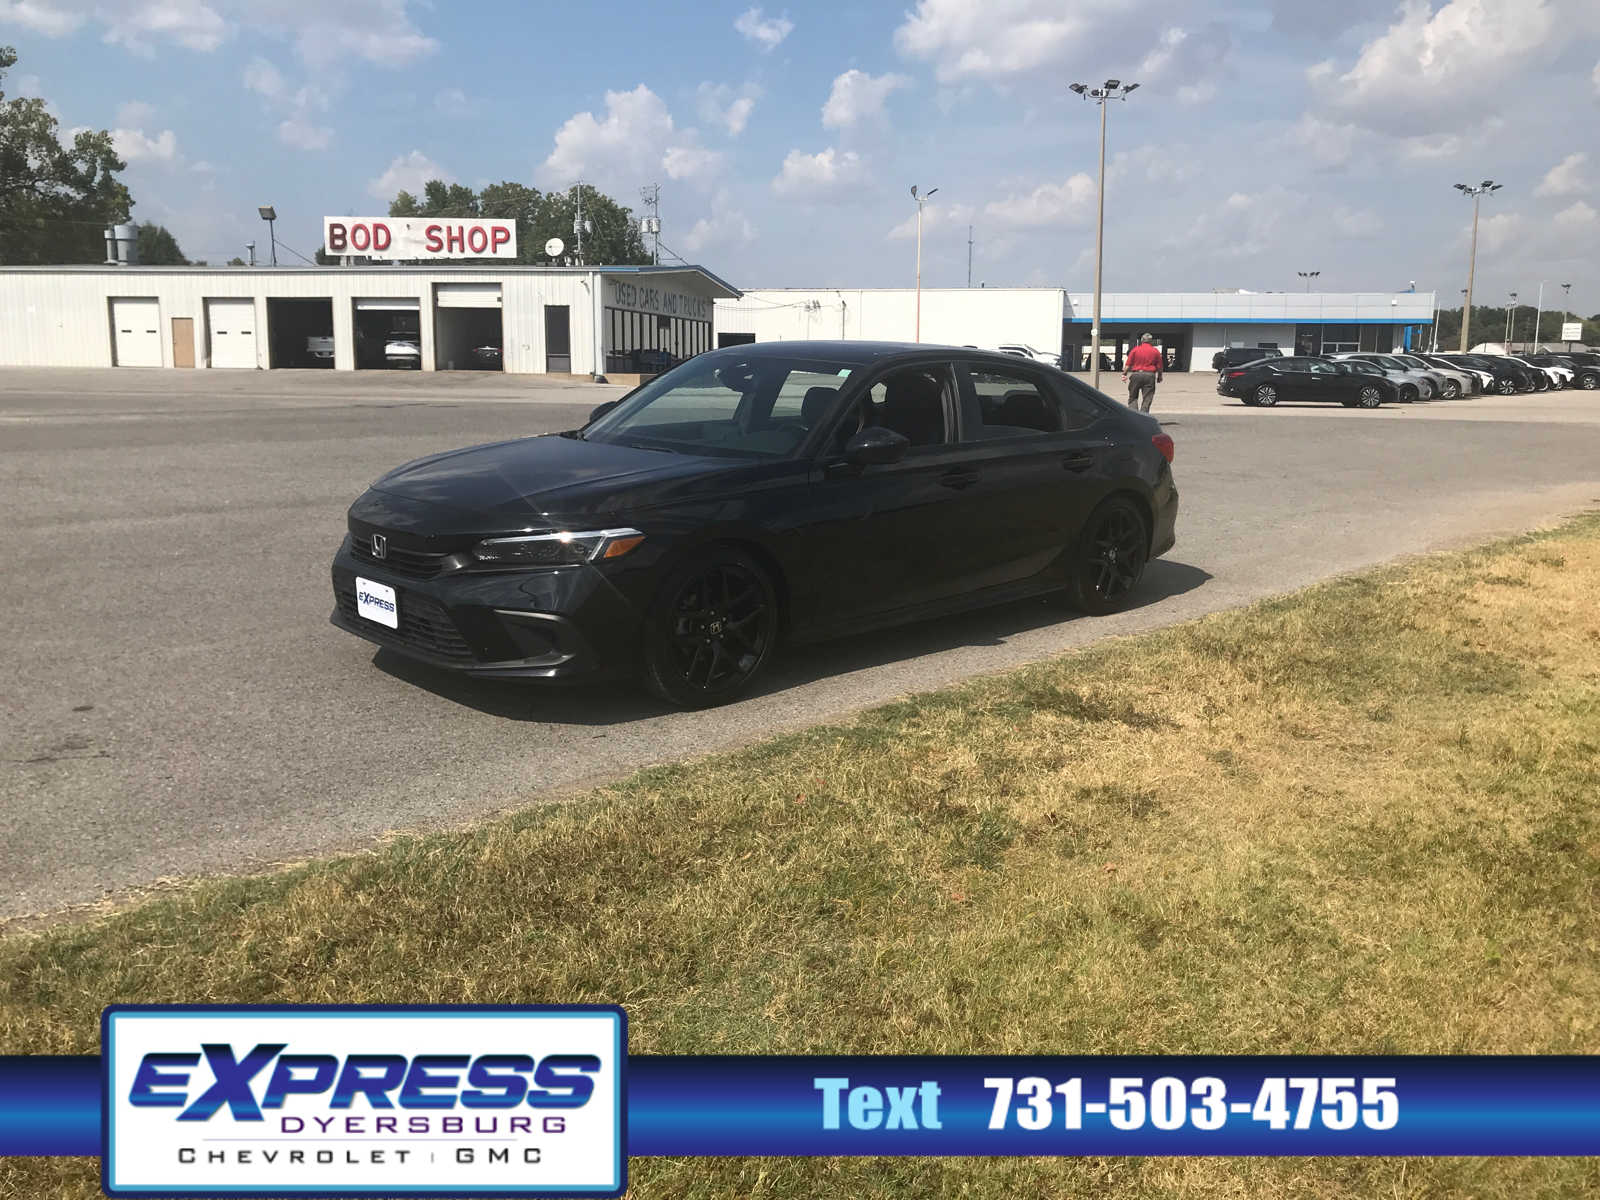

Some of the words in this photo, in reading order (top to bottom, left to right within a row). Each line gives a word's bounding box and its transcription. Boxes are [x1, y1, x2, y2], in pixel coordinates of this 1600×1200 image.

[329, 223, 392, 251] BOD
[425, 224, 511, 254] SHOP
[615, 281, 637, 307] USED
[639, 287, 660, 312] CARS
[663, 292, 677, 314] AND
[679, 295, 706, 318] TRUCKS
[358, 591, 395, 613] EXPRESS
